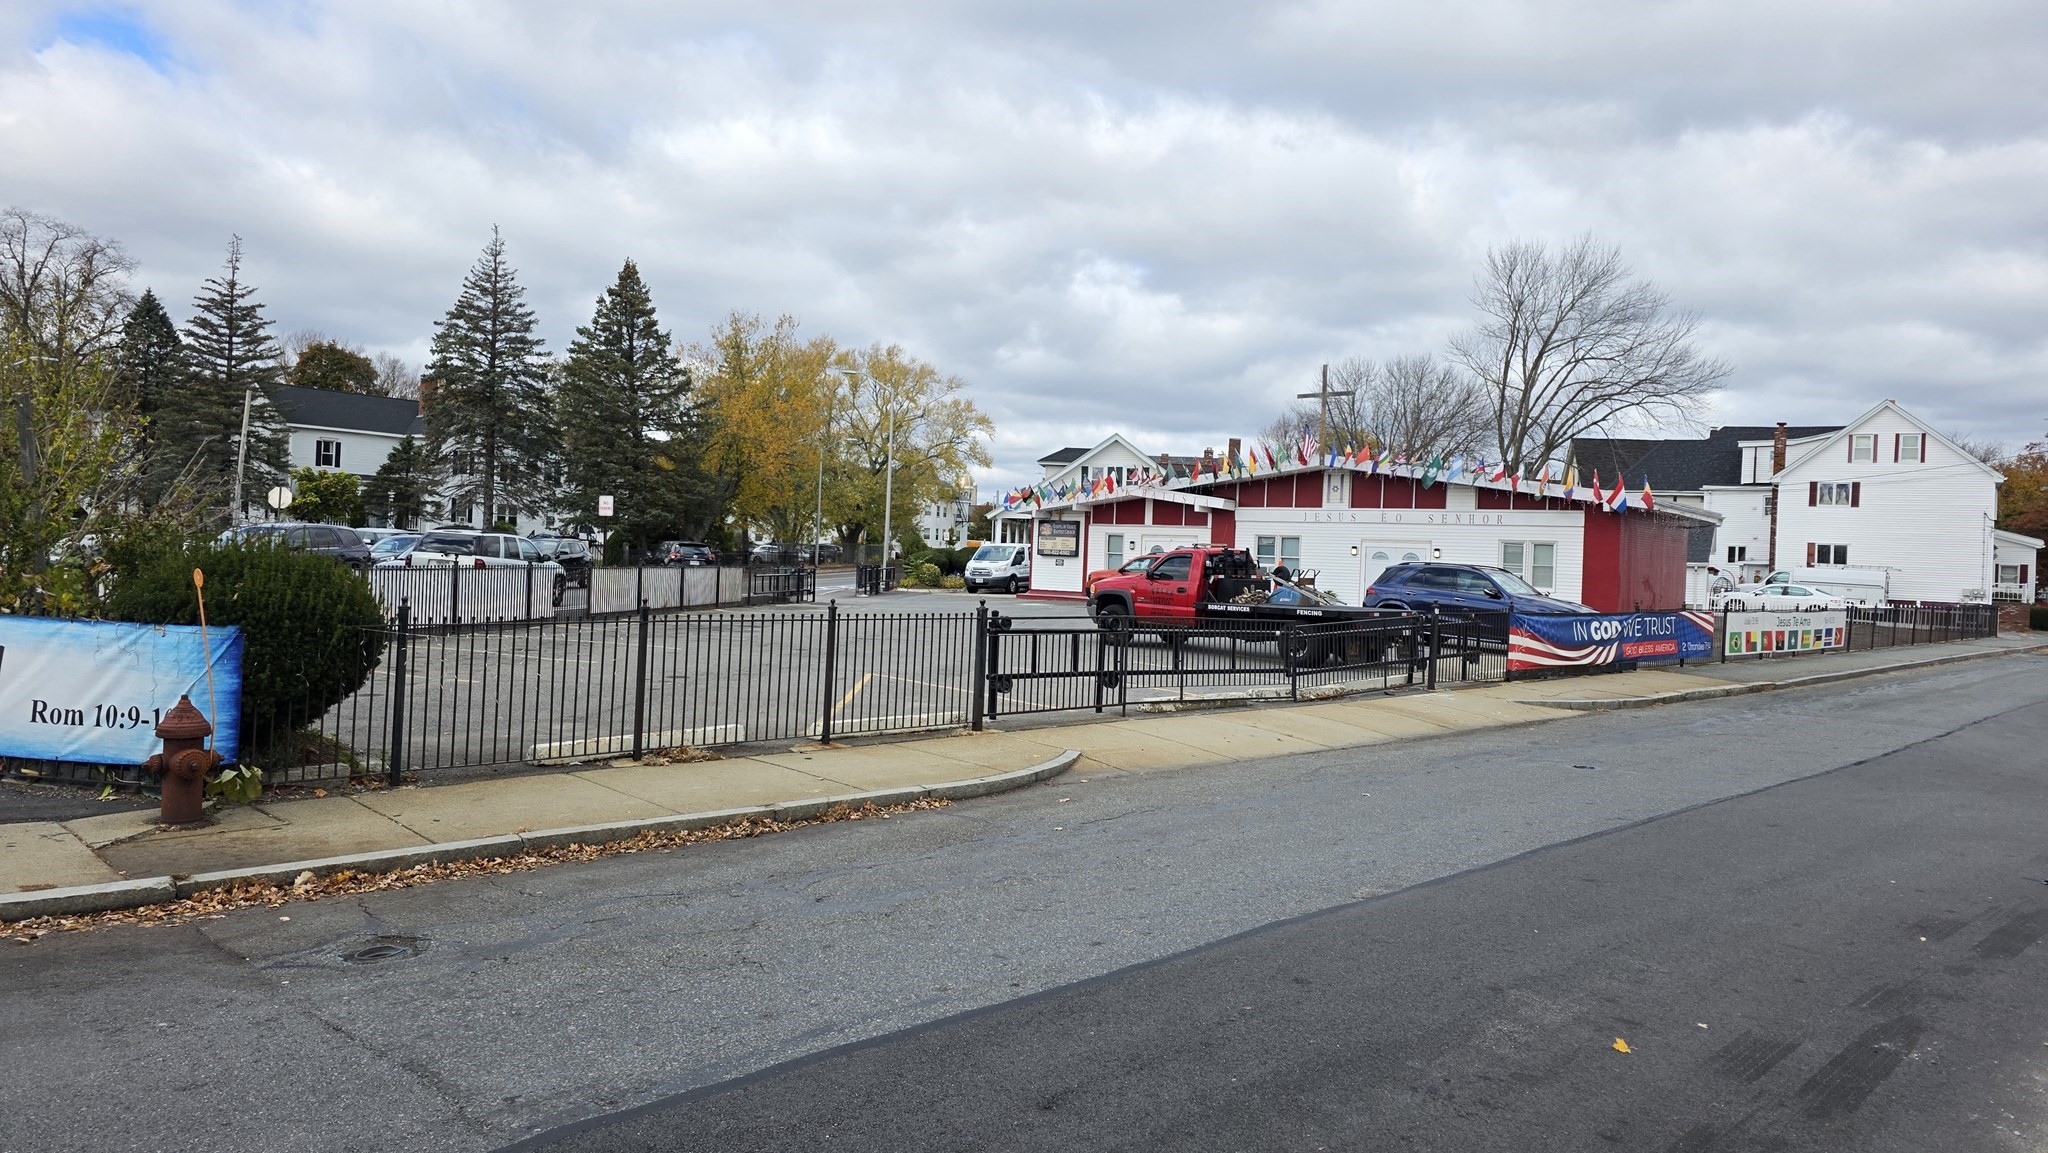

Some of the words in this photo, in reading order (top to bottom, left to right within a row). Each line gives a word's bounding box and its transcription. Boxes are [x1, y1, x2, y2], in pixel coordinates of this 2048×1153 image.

[1304, 512, 1357, 523] JESUS
[1428, 513, 1504, 525] SENHOR
[1776, 616, 1791, 627] Jesus
[1792, 616, 1799, 627] Te
[1799, 616, 1811, 626] Ama
[1573, 621, 1588, 641] IN
[1590, 621, 1622, 641] GOD
[1623, 619, 1642, 637] WE
[1643, 616, 1677, 636] TRUST
[1638, 645, 1654, 654] BLESS
[1654, 643, 1676, 653] AMERICA
[1681, 641, 1687, 651] 2
[29, 699, 84, 727] Rom
[92, 703, 170, 731] 10:9-1
